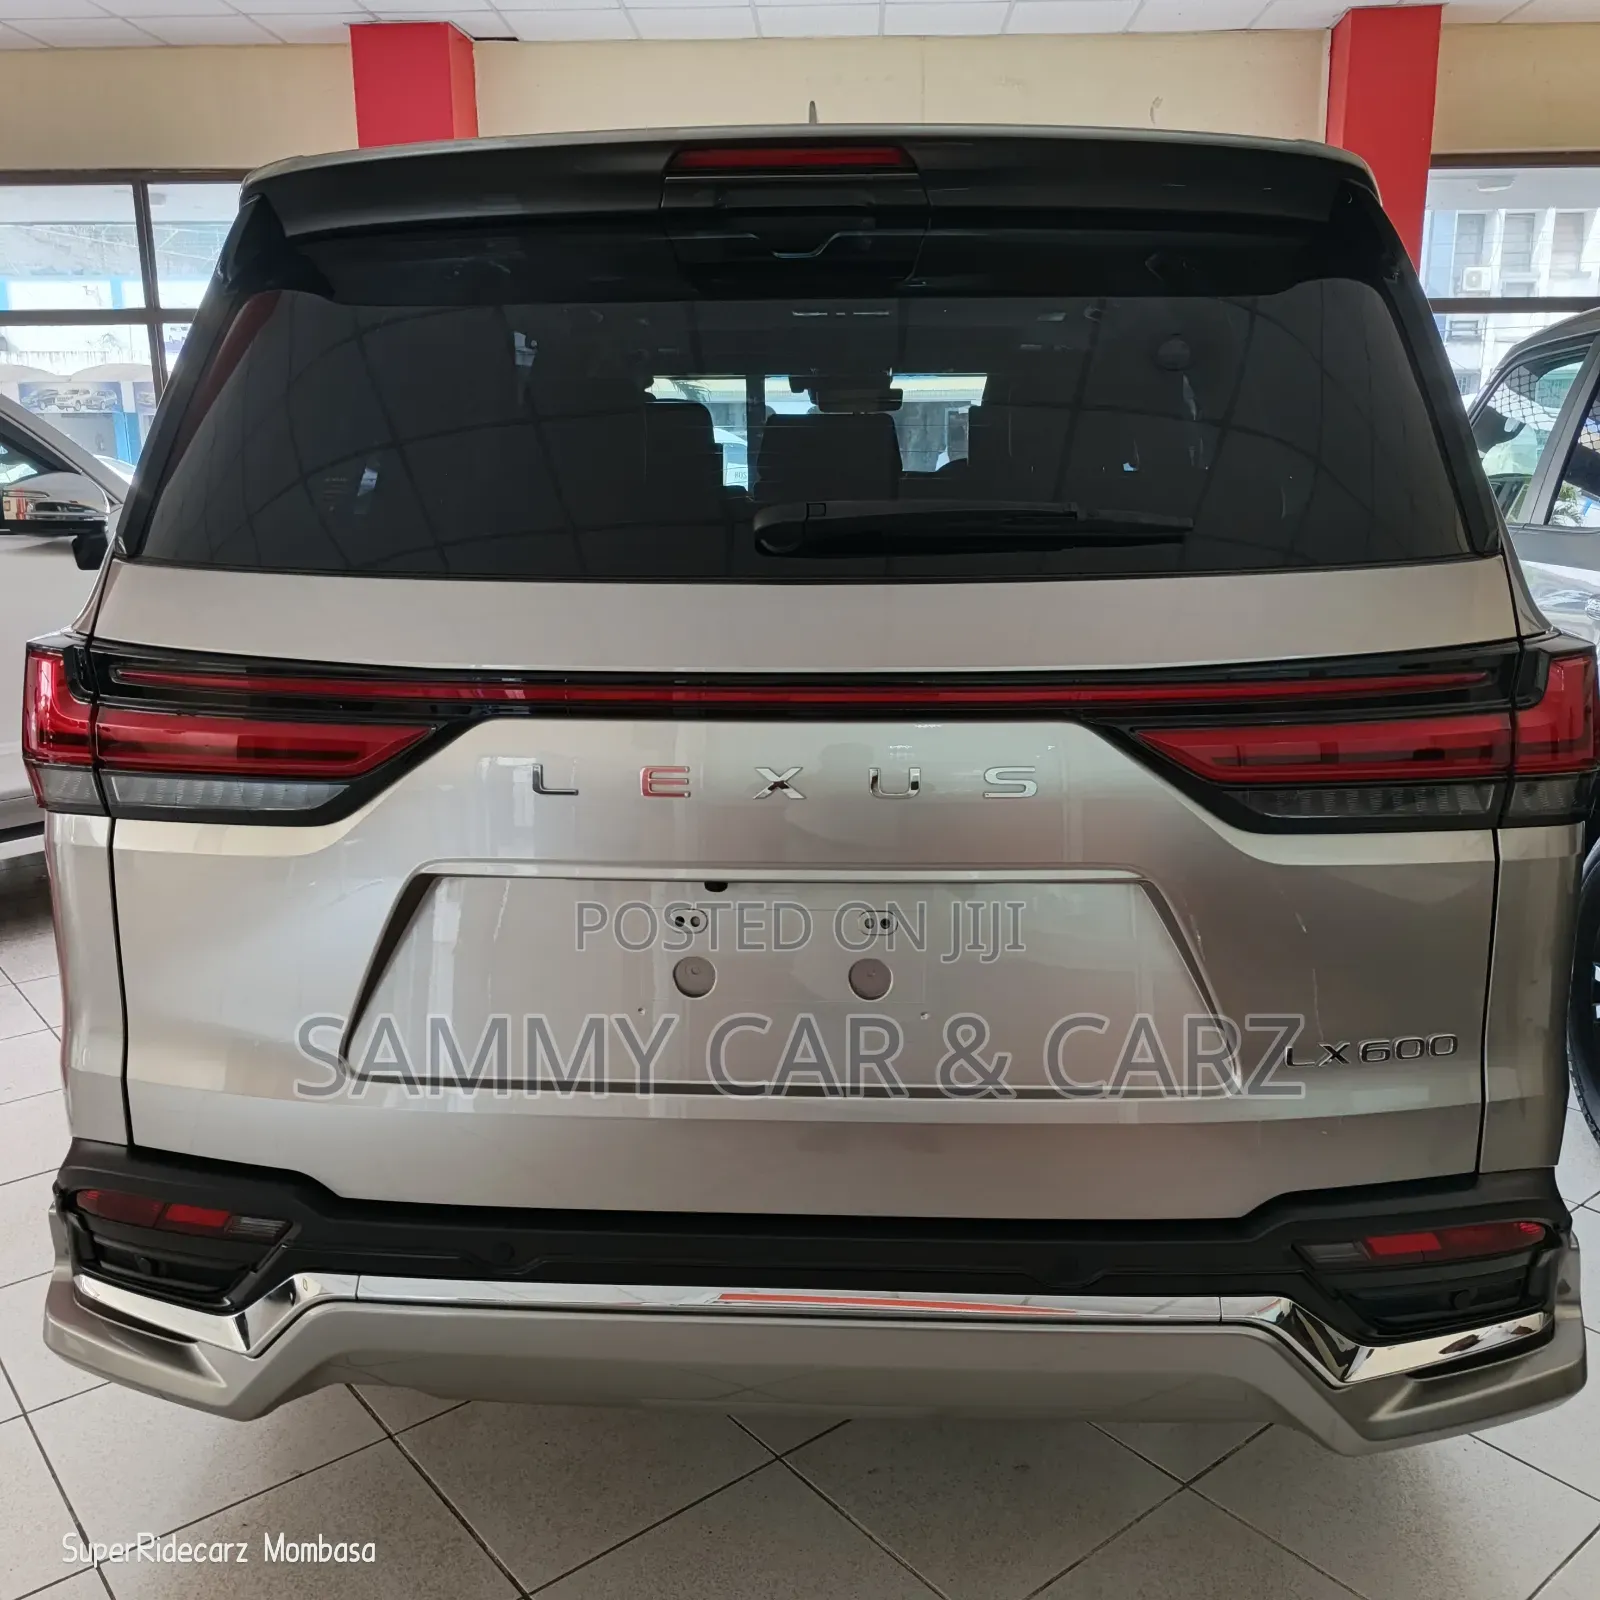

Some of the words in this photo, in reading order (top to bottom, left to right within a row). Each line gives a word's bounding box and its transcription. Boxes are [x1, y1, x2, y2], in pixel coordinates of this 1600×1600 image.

[532, 764, 1038, 799] LEXUS
[1284, 1041, 1350, 1067] LX
[1358, 1034, 1458, 1063] 600
